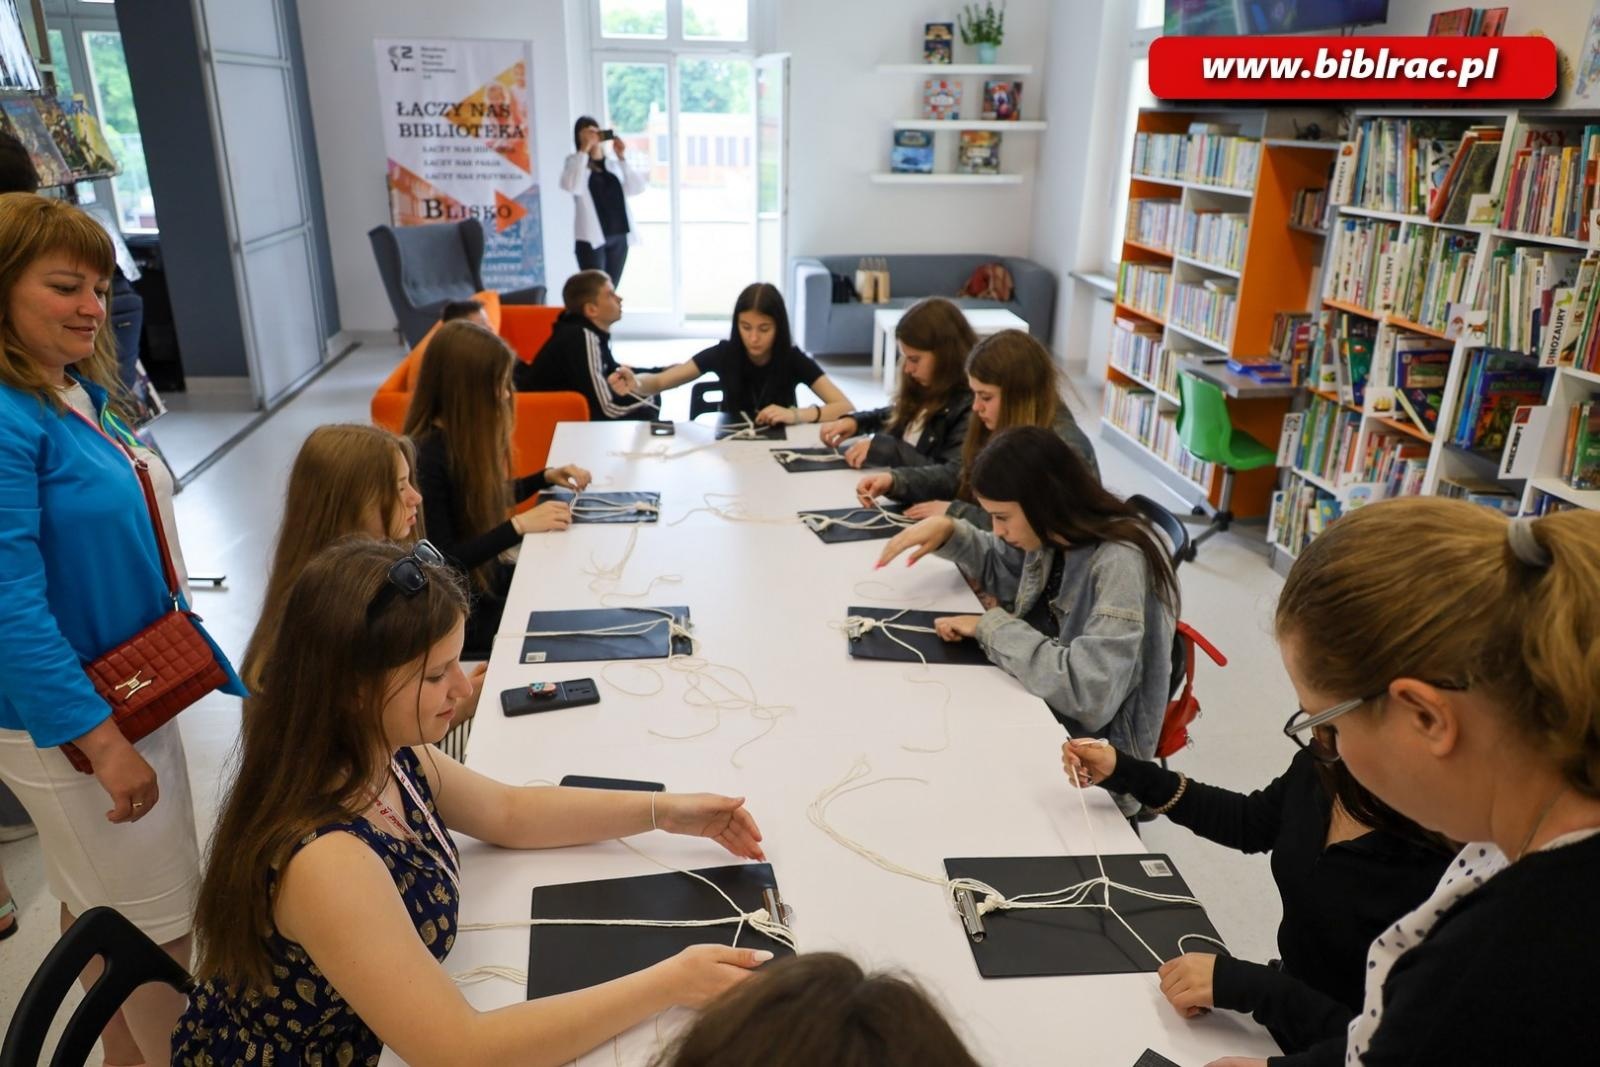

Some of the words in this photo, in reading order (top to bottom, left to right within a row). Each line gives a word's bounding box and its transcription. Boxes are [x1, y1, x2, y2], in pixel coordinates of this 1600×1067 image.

[470, 102, 511, 118] NAS
[398, 123, 525, 139] BIBLIOTEKA
[1546, 308, 1567, 366] DINOZAURY
